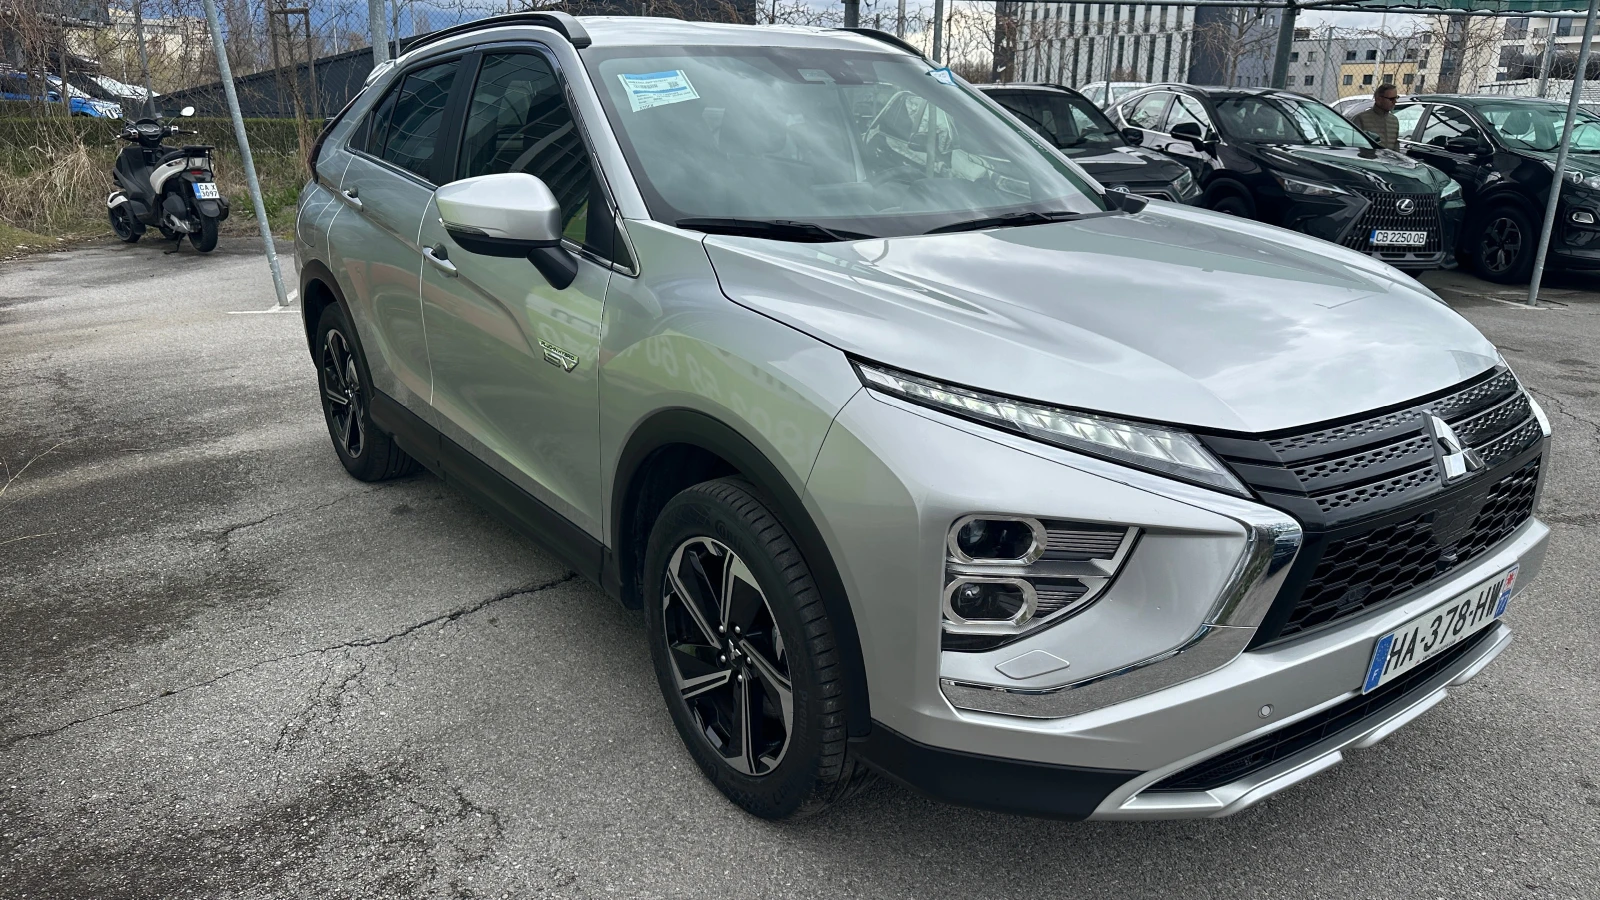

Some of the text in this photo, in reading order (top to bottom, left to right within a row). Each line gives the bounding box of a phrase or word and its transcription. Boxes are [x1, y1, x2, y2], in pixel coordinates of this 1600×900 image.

[1376, 231, 1425, 243] CB 2250 OB
[1383, 578, 1505, 676] HA-378-HW
[1371, 668, 1378, 681] F
